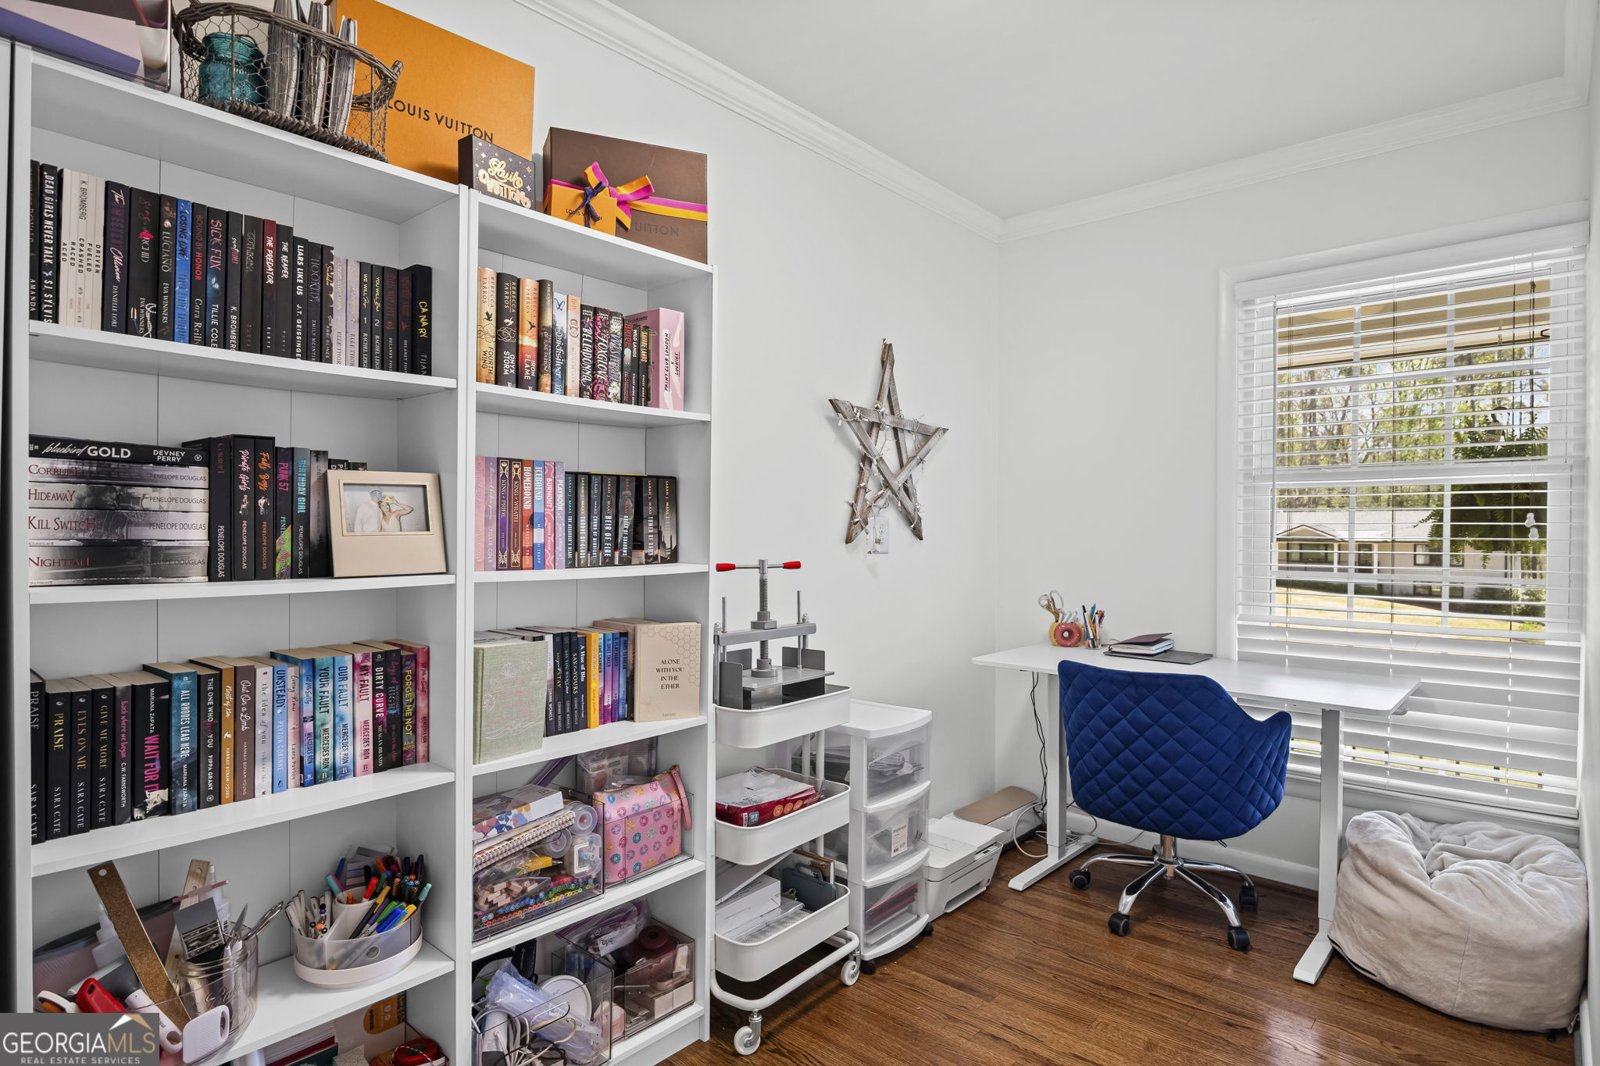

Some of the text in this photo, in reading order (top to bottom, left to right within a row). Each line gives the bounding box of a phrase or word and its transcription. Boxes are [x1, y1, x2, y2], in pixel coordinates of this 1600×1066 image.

[435, 111, 494, 143] VUITTON
[44, 220, 53, 244] NEVER
[43, 246, 53, 263] TALK
[265, 249, 273, 284] PREDATOR
[296, 286, 303, 296] US
[194, 299, 202, 318] Cora
[418, 301, 429, 338] CANARY
[87, 446, 131, 459] GOLD
[279, 482, 288, 491] 57
[297, 497, 306, 514] GIRL
[338, 665, 348, 682] OUR
[181, 690, 190, 700] ALL
[319, 666, 329, 714] YOUR FAULT
[375, 667, 384, 718] DIRTY CURVE
[405, 705, 411, 716] ME
[53, 713, 64, 750] PRAISE
[144, 734, 160, 759] WAIT
[144, 763, 159, 782] FOR
